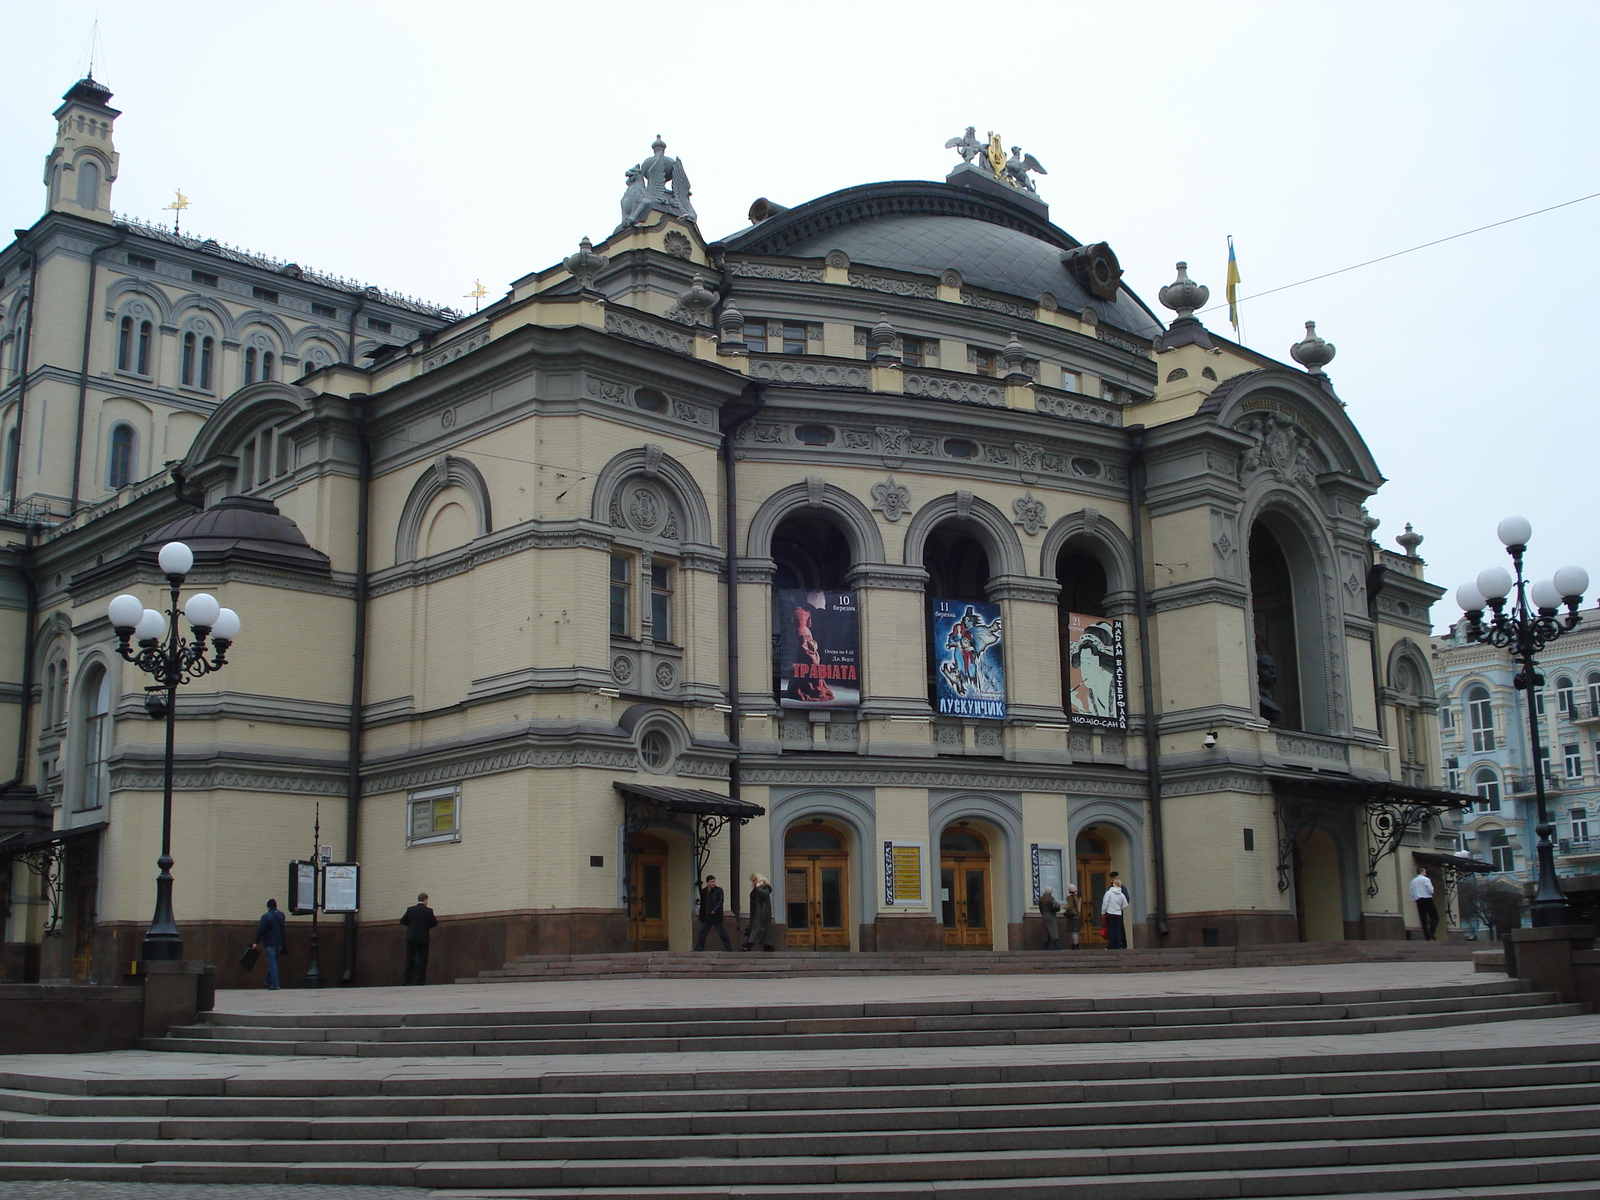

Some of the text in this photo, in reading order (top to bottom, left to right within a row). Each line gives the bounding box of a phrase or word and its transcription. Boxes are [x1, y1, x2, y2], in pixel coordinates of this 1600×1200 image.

[839, 595, 850, 605] 10
[940, 602, 949, 612] 11
[1072, 617, 1081, 626] 21
[792, 663, 857, 680] ТРАВІАТА
[939, 697, 1004, 717] ЛУСКУНЧИК
